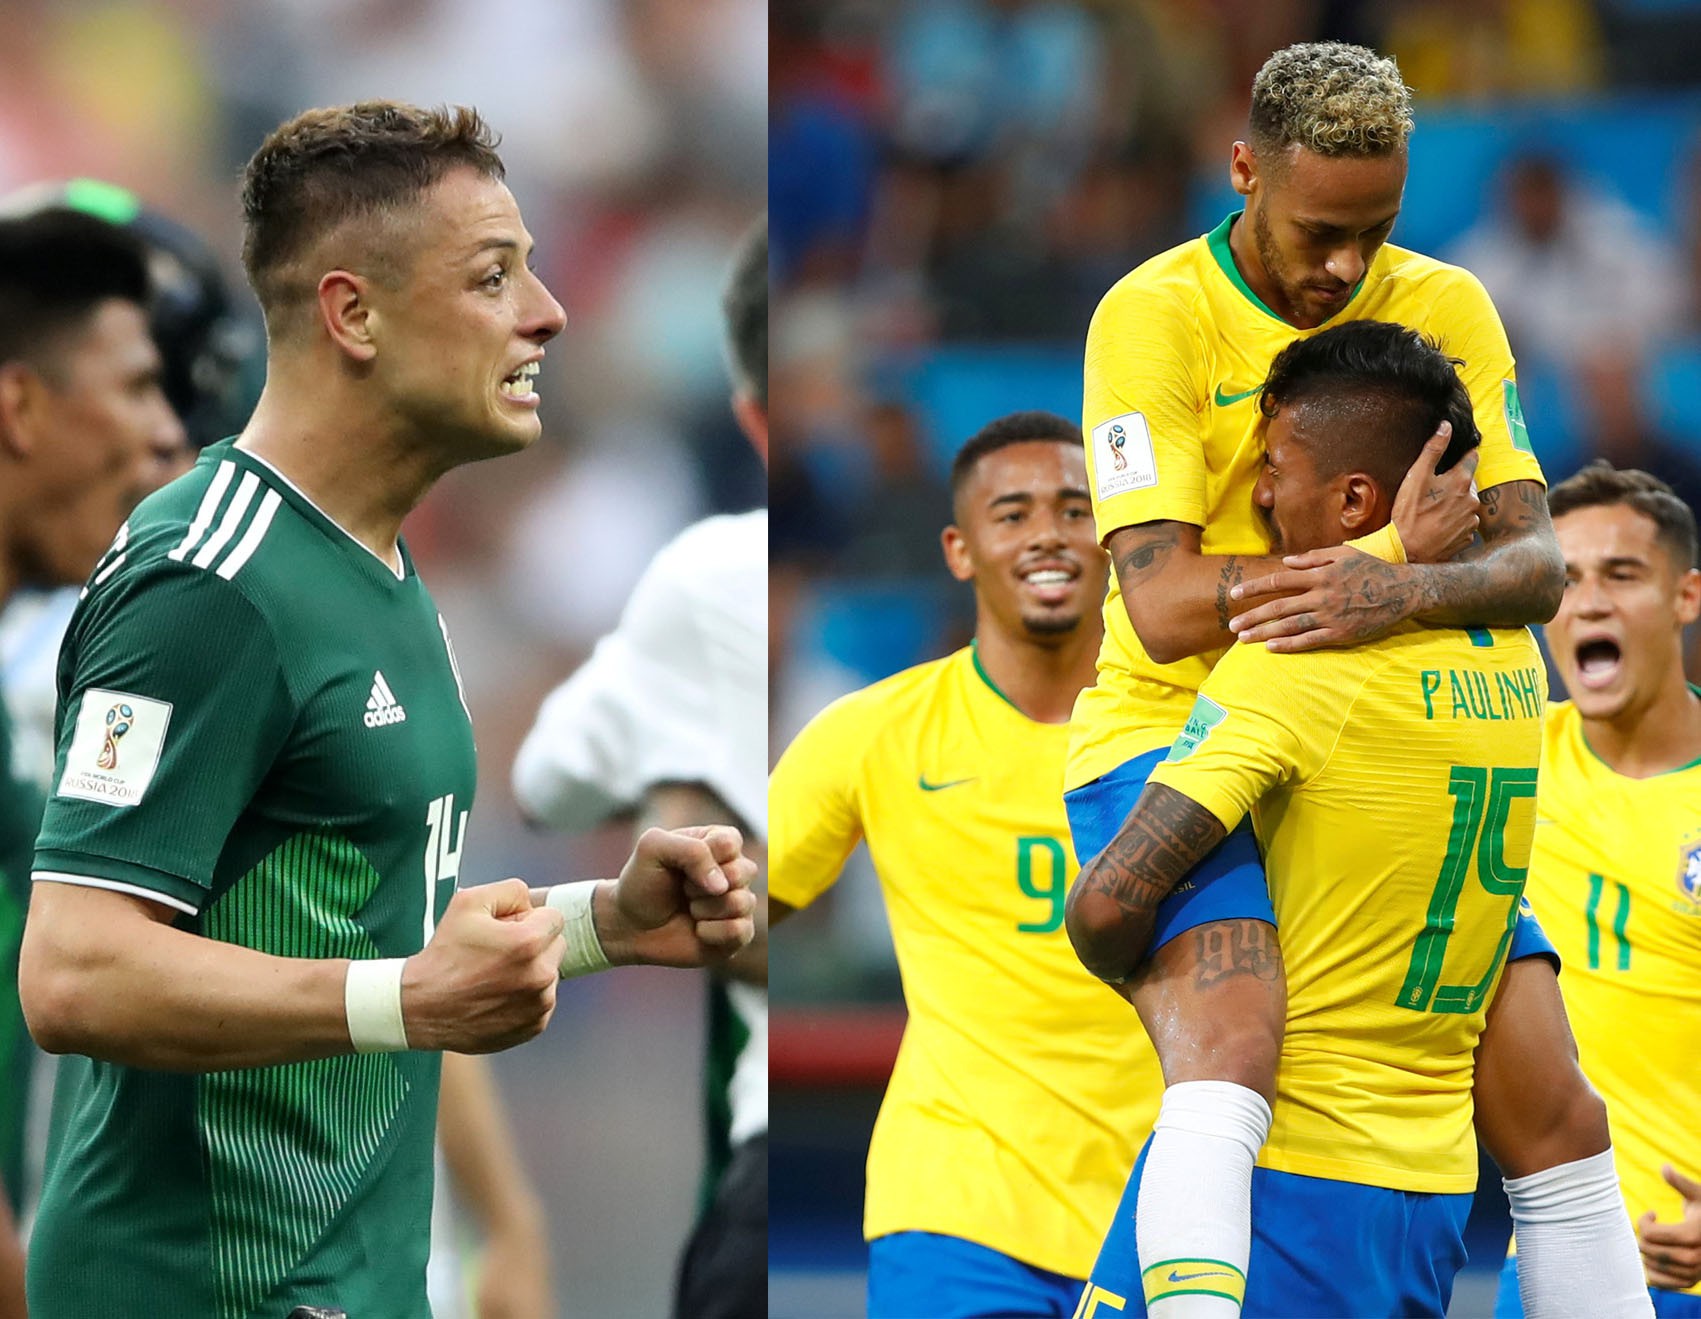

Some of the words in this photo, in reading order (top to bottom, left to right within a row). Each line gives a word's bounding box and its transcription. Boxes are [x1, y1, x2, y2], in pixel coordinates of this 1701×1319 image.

[363, 704, 407, 728] adidas
[1188, 716, 1208, 731] ING
[64, 776, 107, 794] RUSSIA
[92, 773, 113, 783] WORLD
[423, 792, 468, 949] 14
[1017, 836, 1066, 933] 9
[1175, 880, 1196, 895] SIL
[1586, 872, 1631, 971] 11
